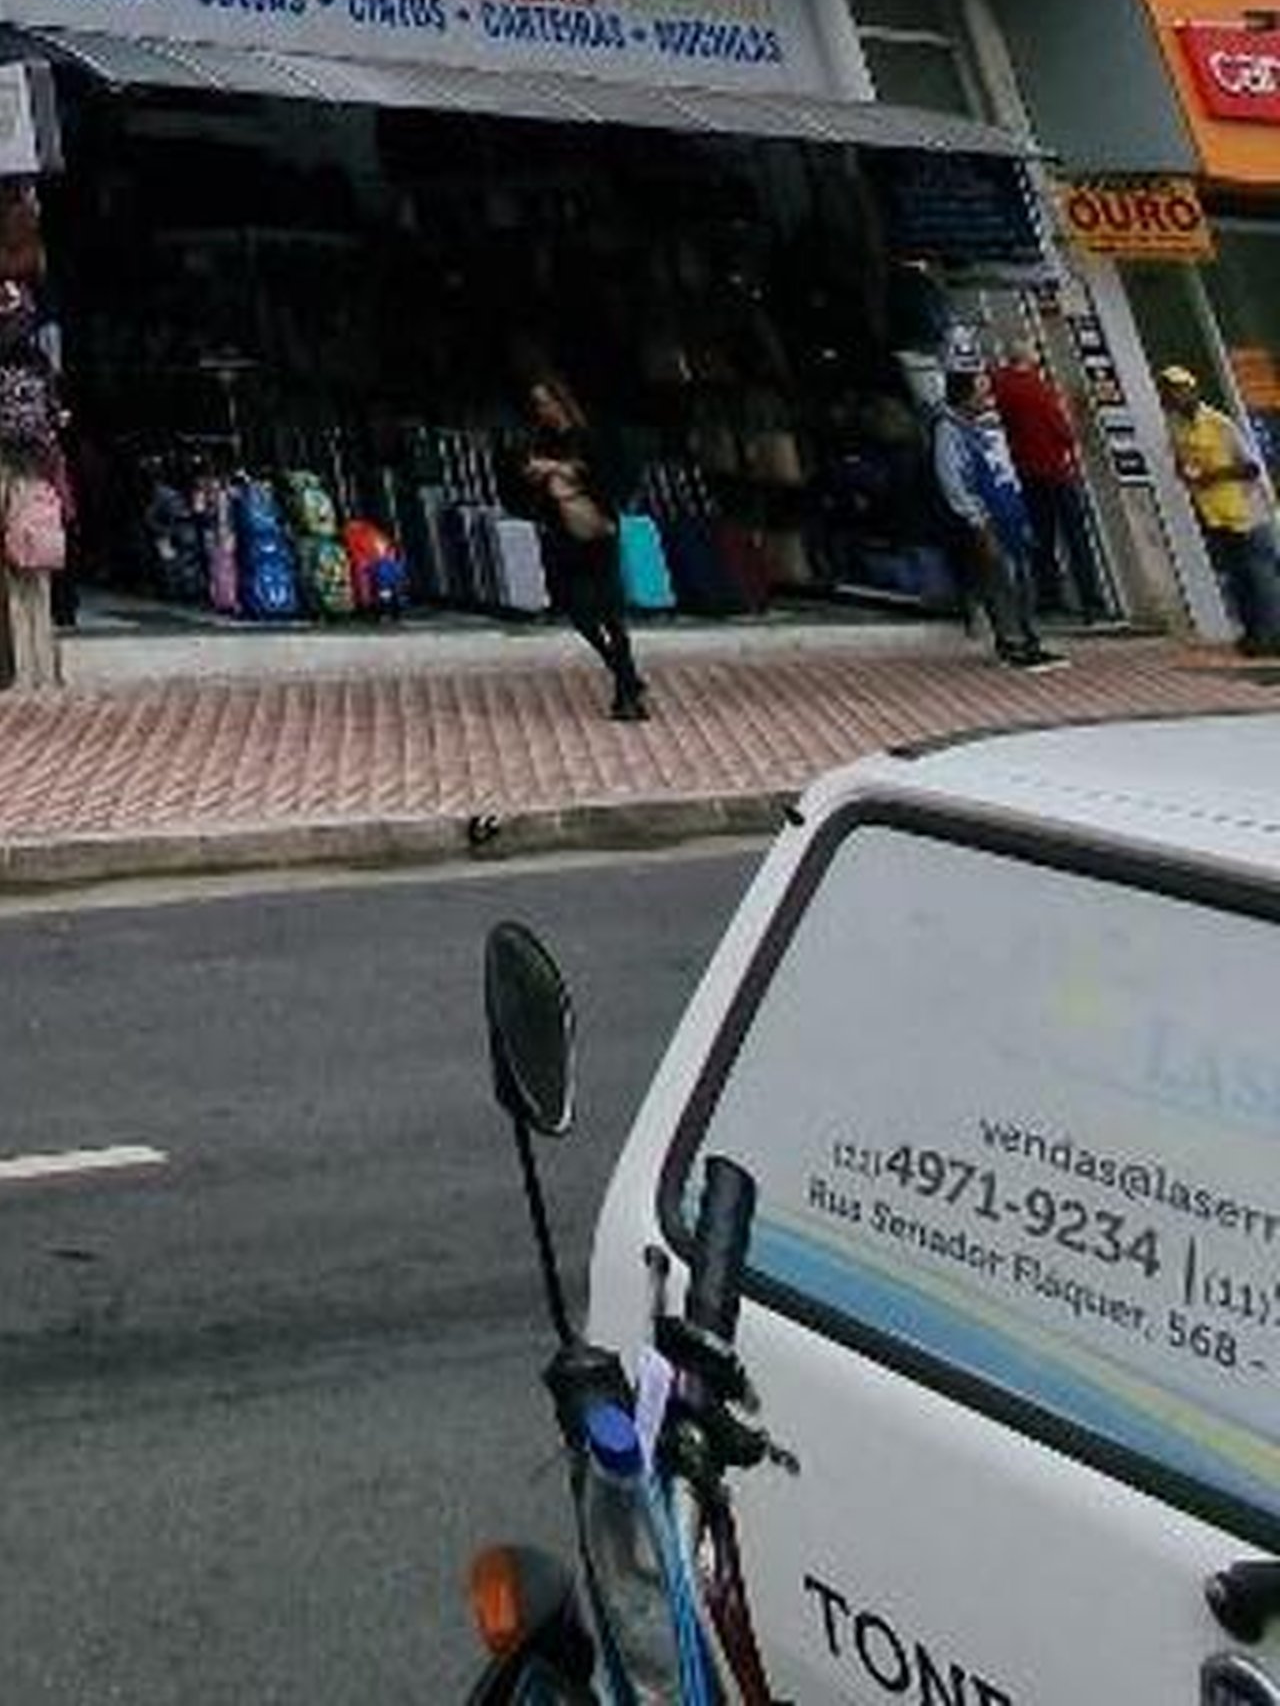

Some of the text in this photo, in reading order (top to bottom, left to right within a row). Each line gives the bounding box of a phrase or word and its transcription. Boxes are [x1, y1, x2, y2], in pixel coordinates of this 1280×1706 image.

[1069, 192, 1200, 232] OURO
[870, 1201, 1006, 1277] Senador
[1168, 1309, 1237, 1368] 568
